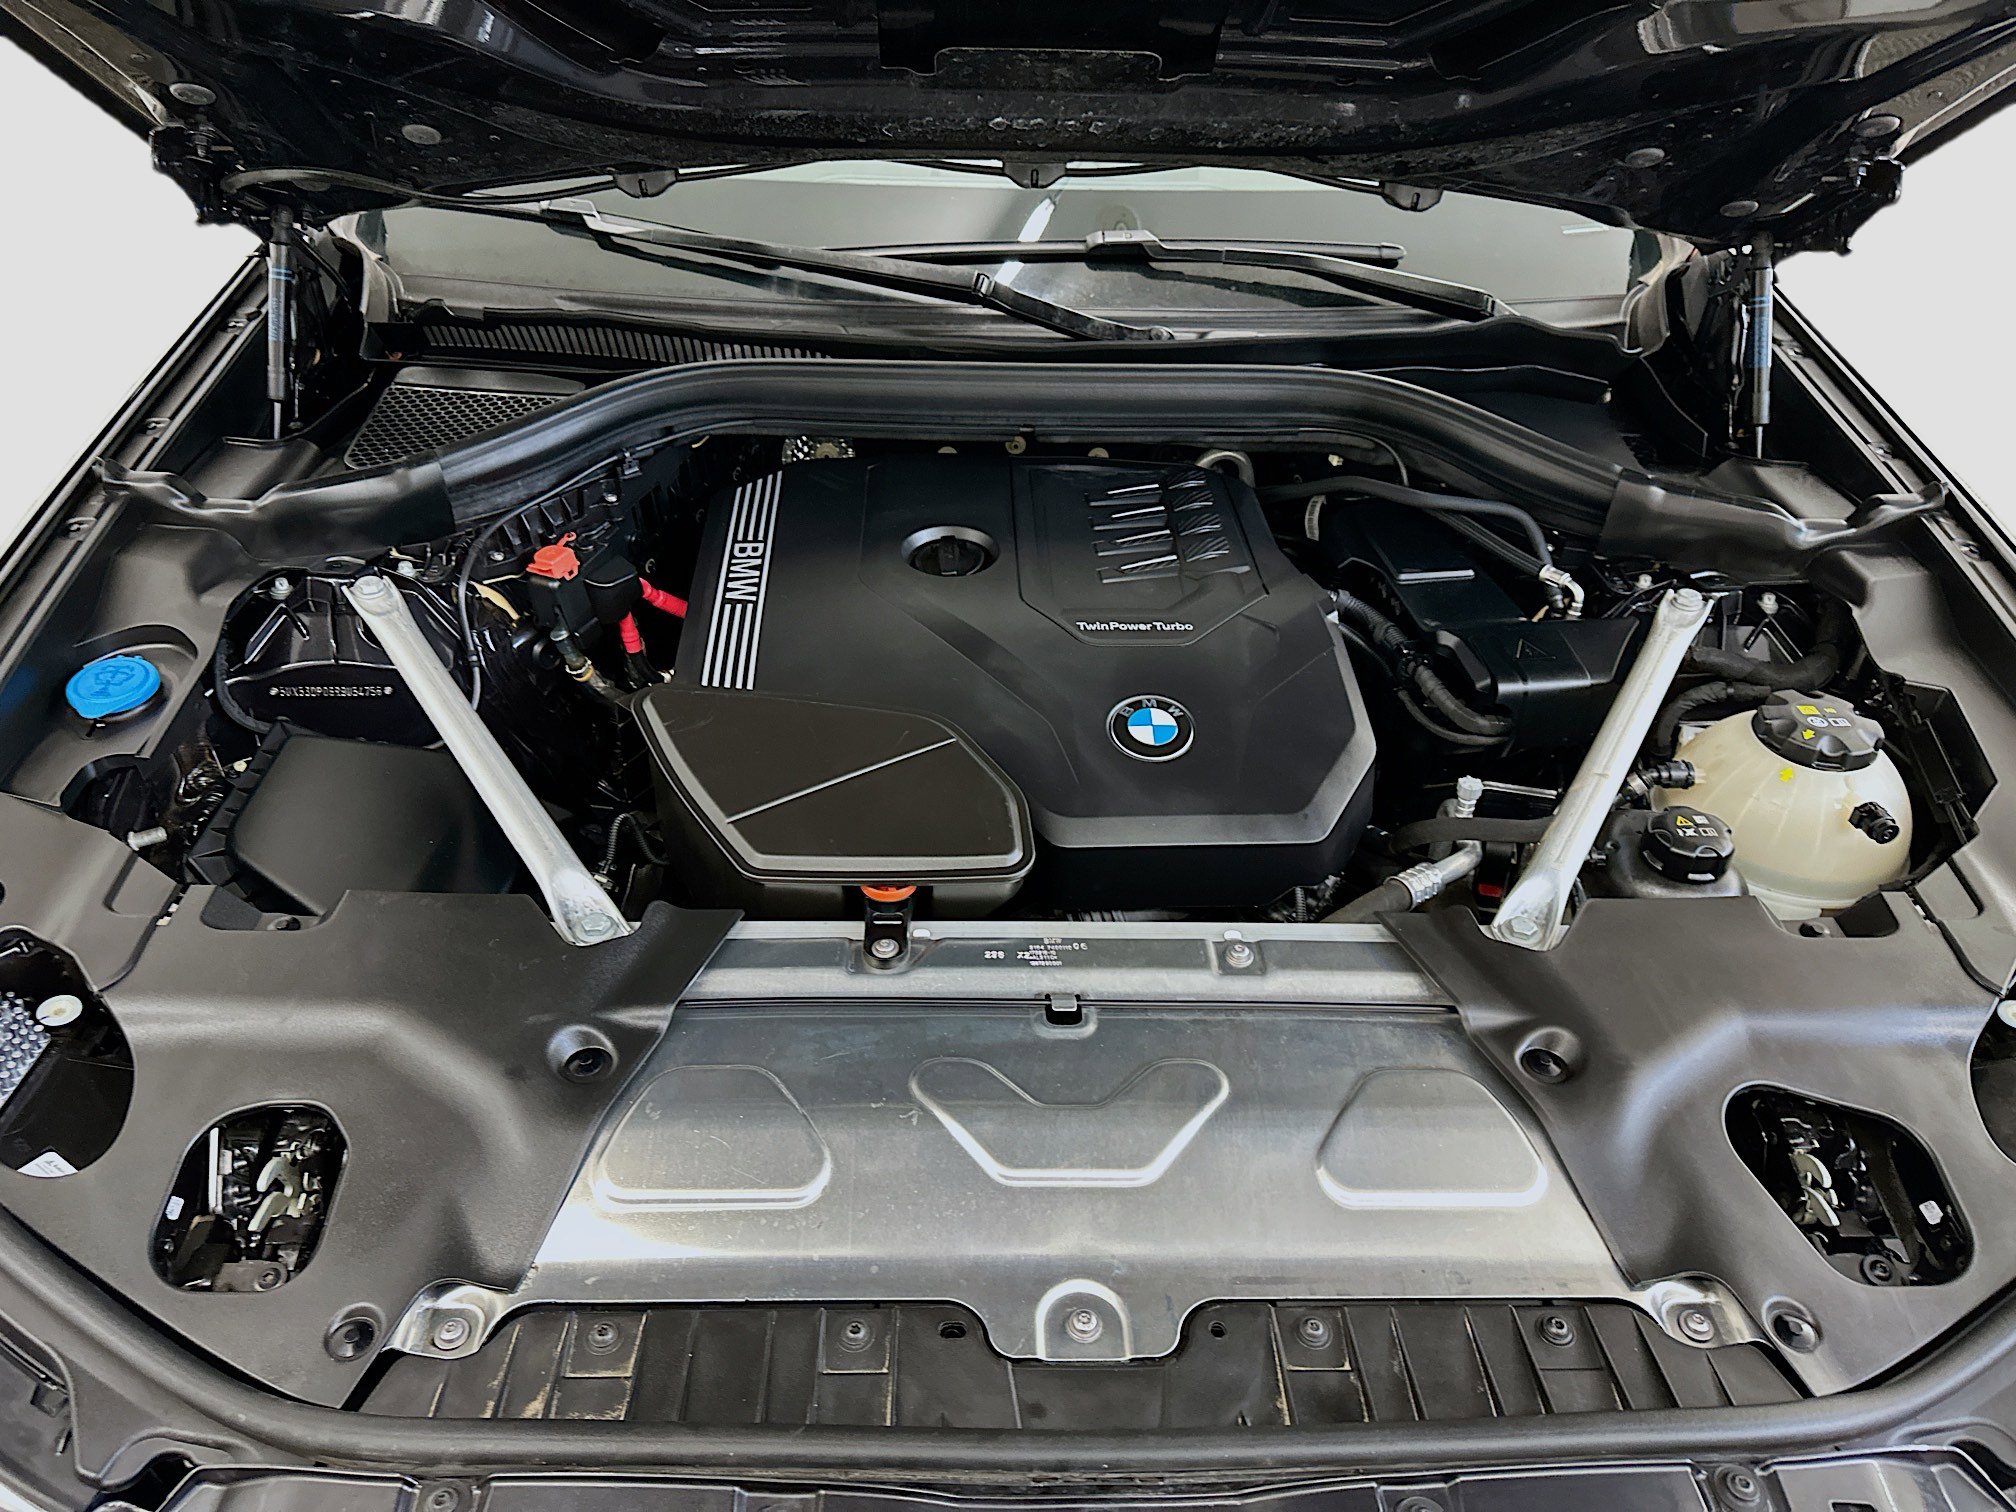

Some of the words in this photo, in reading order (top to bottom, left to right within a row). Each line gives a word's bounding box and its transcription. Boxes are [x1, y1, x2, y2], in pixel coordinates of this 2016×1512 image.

[725, 542, 765, 601] BMW
[1076, 621, 1152, 631] TwinPower
[1152, 621, 1194, 631] Turbo
[1119, 699, 1184, 717] BMW
